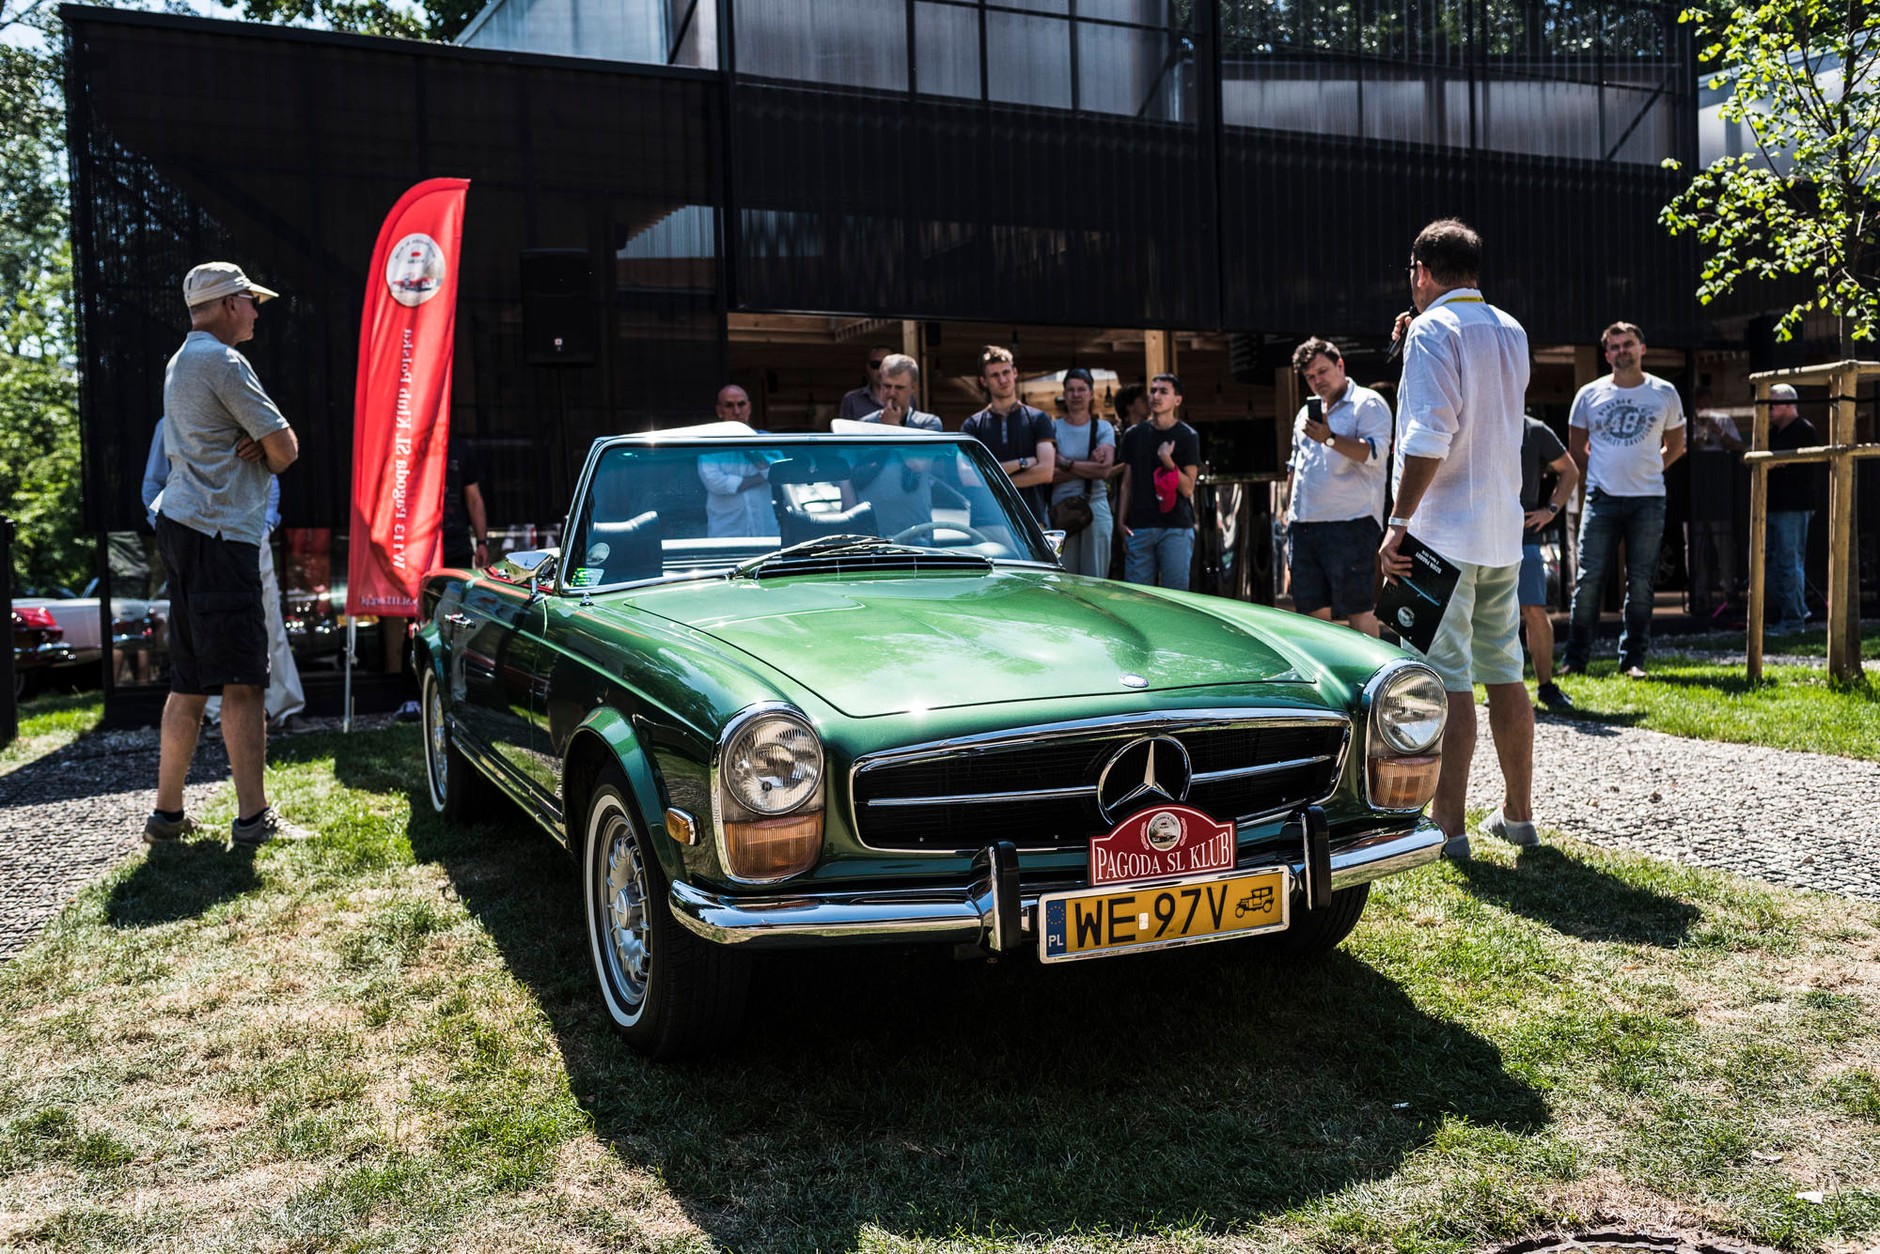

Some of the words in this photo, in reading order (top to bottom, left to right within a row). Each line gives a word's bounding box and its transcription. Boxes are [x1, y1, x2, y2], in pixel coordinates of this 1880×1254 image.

[1611, 411, 1640, 434] 48
[1096, 846, 1163, 880] PAGODA
[1166, 851, 1186, 873] SL
[1190, 831, 1230, 870] KLUB
[1075, 896, 1137, 948] WE
[1154, 884, 1229, 938] 97V
[1048, 934, 1064, 948] PL
